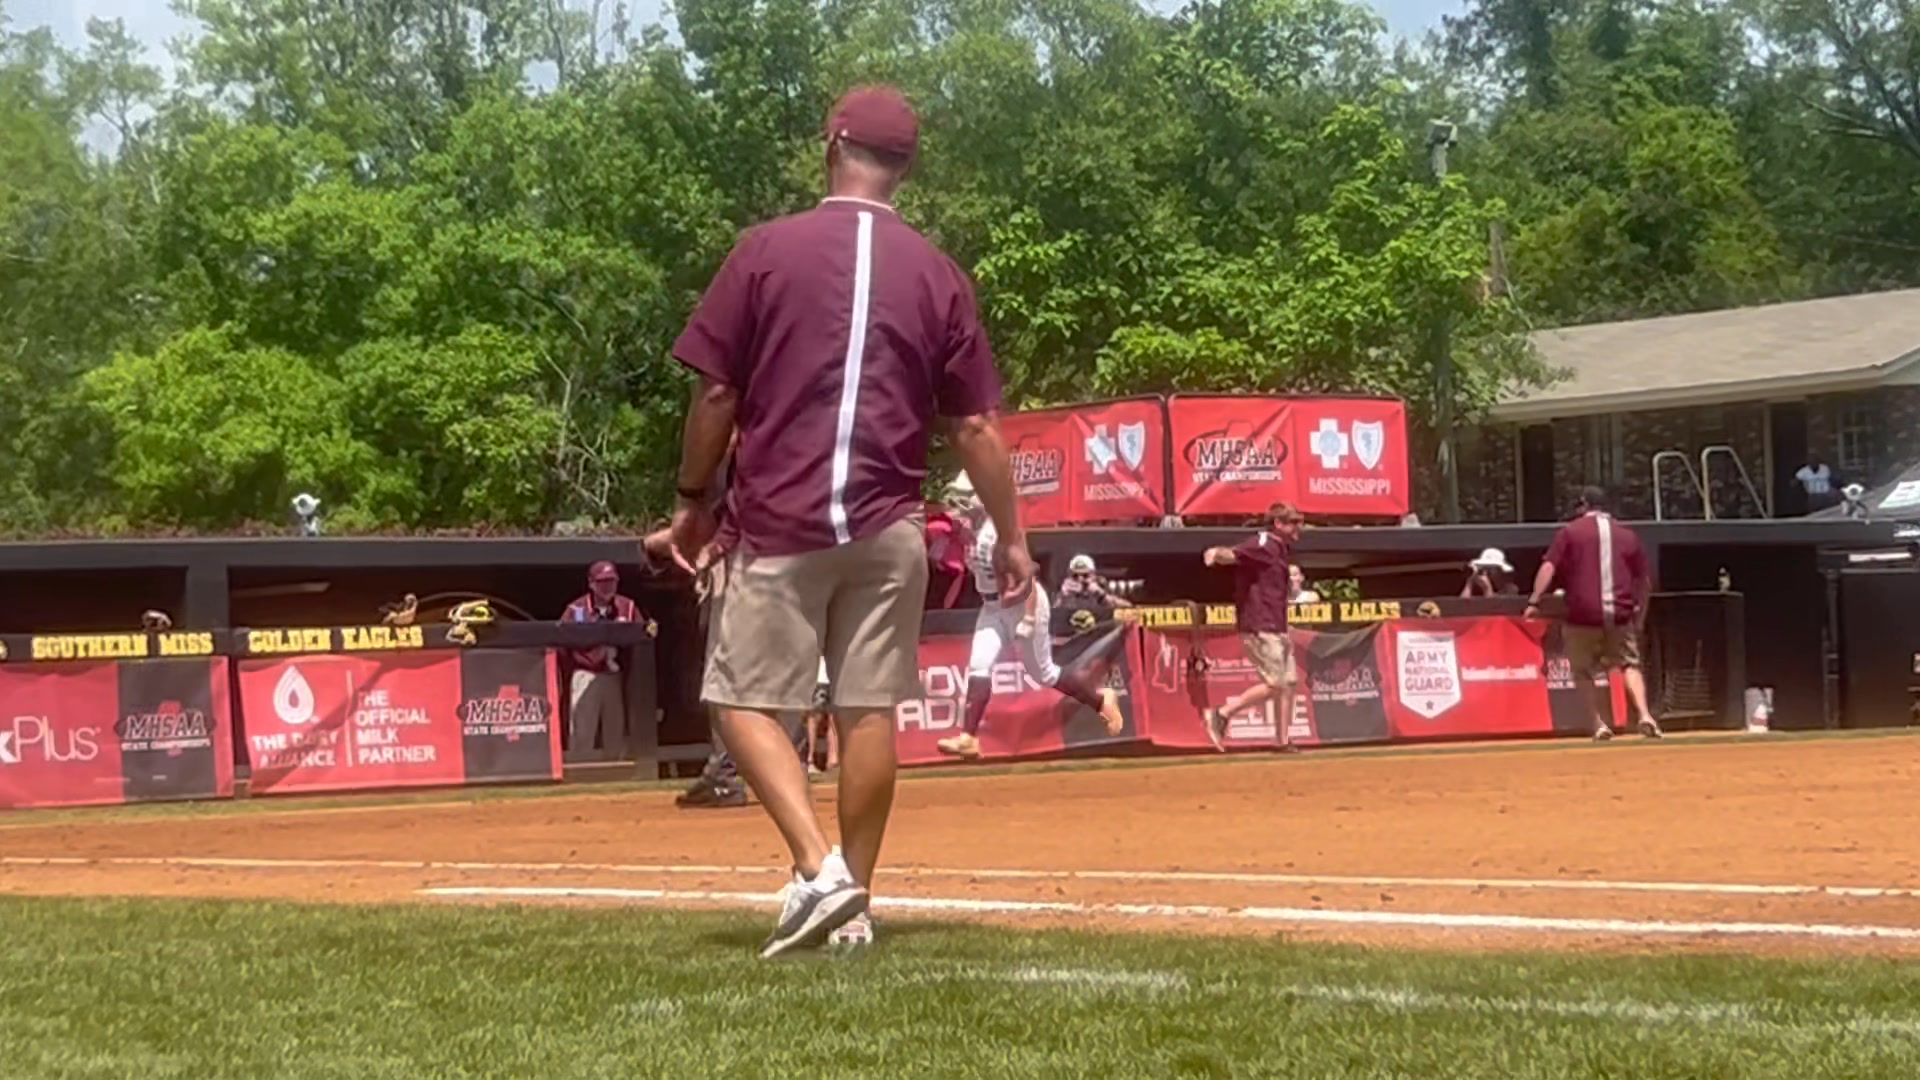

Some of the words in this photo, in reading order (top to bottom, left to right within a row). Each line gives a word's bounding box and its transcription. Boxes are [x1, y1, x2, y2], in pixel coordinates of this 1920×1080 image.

[1195, 438, 1278, 469] MHSAA
[1009, 449, 1058, 482] HSAA
[1309, 478, 1390, 495] MISSISSIPPI
[1206, 605, 1237, 625] MIS
[1340, 601, 1399, 622] EAGLES
[32, 634, 148, 658] SOUTHERN
[158, 632, 213, 655] MISS
[249, 628, 331, 652] GOLDEN
[341, 625, 423, 649] EAGLES
[1405, 651, 1447, 664] ARMY
[1404, 677, 1453, 691] GUARD
[358, 690, 389, 707] THE
[355, 708, 431, 726] OFFICIAL
[465, 697, 544, 724] MHSAA
[125, 711, 206, 739] MHSAA
[252, 734, 289, 752] THE
[357, 727, 399, 744] MILK
[358, 746, 437, 764] PARTNER
